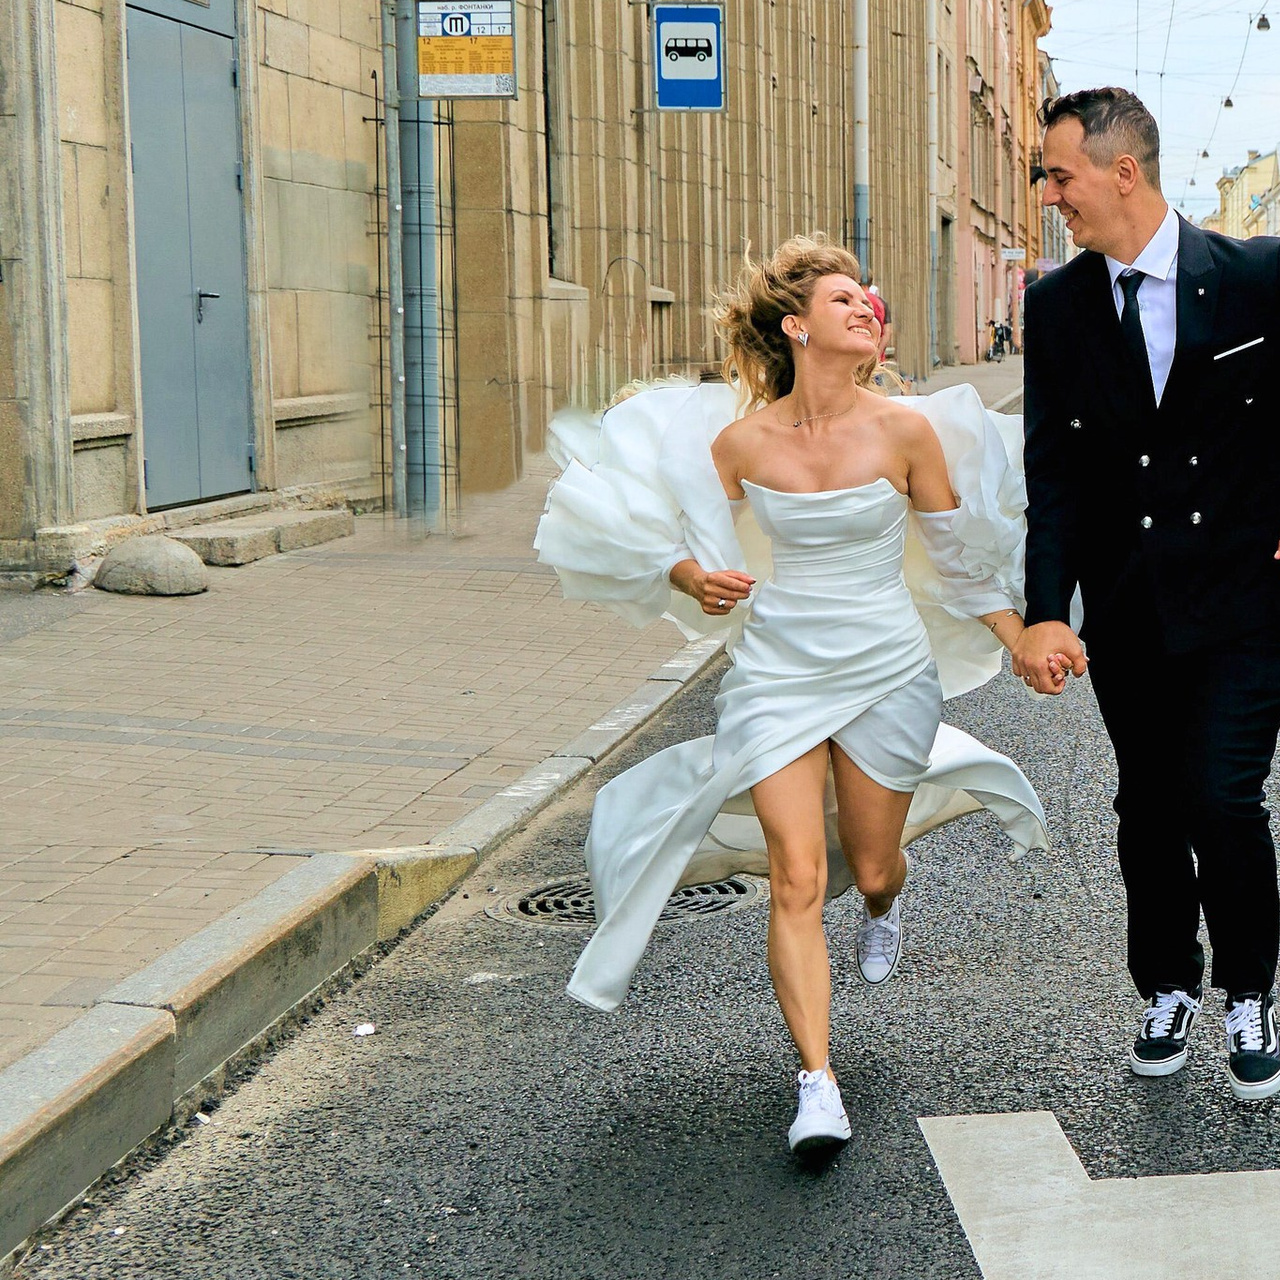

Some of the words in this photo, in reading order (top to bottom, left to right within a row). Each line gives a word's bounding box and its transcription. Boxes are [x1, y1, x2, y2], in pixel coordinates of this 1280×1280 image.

[477, 26, 486, 34] 12
[497, 26, 506, 34] 17
[469, 37, 478, 45] 17
